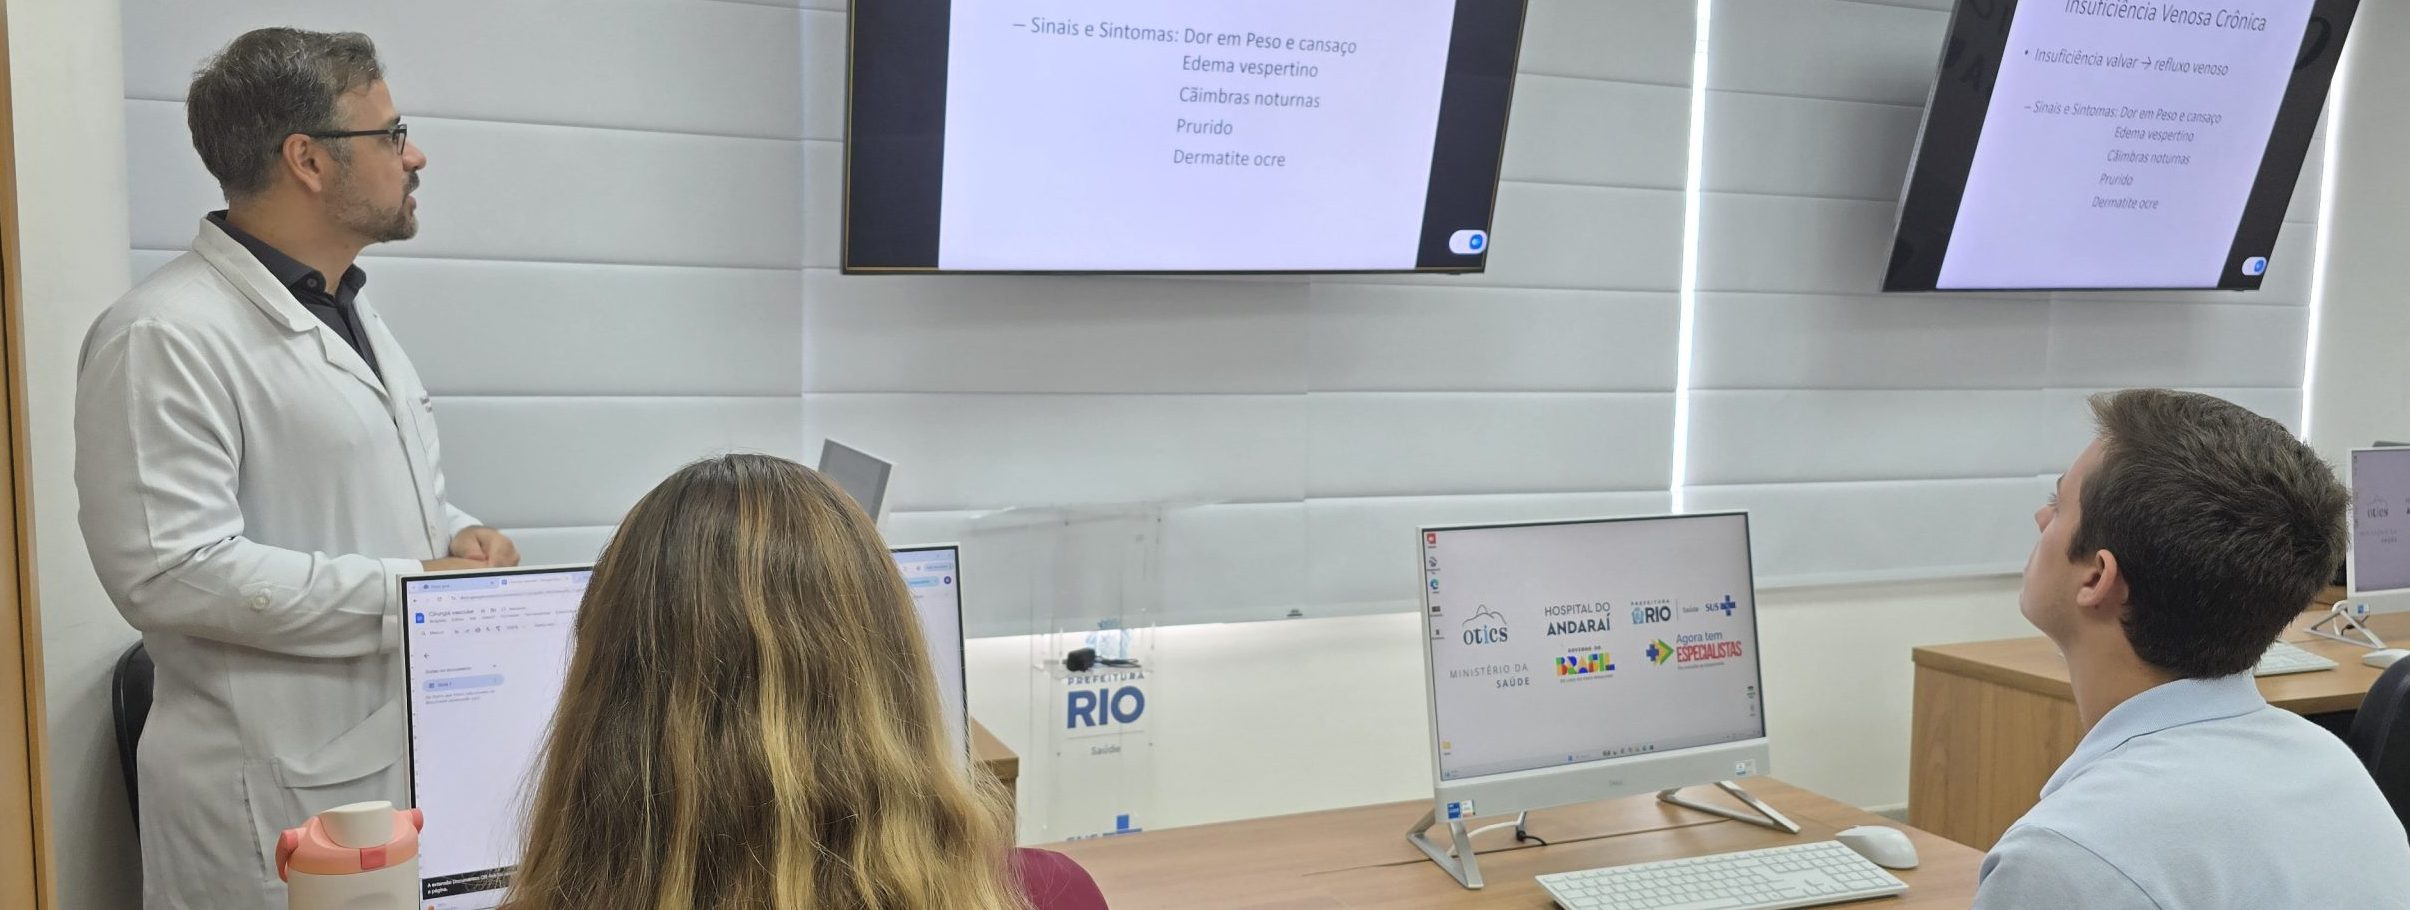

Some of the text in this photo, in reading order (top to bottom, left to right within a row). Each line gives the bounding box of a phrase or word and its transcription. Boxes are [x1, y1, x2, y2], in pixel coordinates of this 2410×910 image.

[2065, 0, 2267, 32] Insuficiência Venosa Crônica
[1031, 17, 1357, 57] Sinais e Sintomas: Dor em Peso e cansaço
[1182, 56, 1319, 79] Edema vespertino
[2035, 48, 2229, 76] Insuficiência valvar refluxo venoso
[1179, 86, 1320, 109] Cãimbras noturnas
[2033, 101, 2222, 126] Sinais e Sintomas: Dor em Peso e cansaço
[1176, 118, 1233, 136] Prurido
[2114, 127, 2194, 142] Edema vespertino
[1173, 149, 1286, 168] Dermatite ocre
[2150, 152, 2190, 165] noturnas
[2099, 173, 2134, 186] Prurido
[2092, 196, 2159, 209] Dermatite ocre
[1545, 602, 1611, 617] HOSPITAL DO
[1645, 606, 1671, 623] RIO
[1705, 603, 1719, 611] SUS
[1547, 614, 1611, 636] ANDARAÍ
[1463, 625, 1508, 646] otics
[1676, 632, 1722, 644] Agora tem
[1677, 641, 1742, 662] ESPECIALISTAS
[1450, 664, 1529, 679] MINISTÉRIO DA
[1556, 652, 1616, 676] BRASIL
[1068, 673, 1145, 685] PREFEITURA
[1496, 675, 1531, 688] SAÚDE
[1067, 686, 1145, 728] RIO
